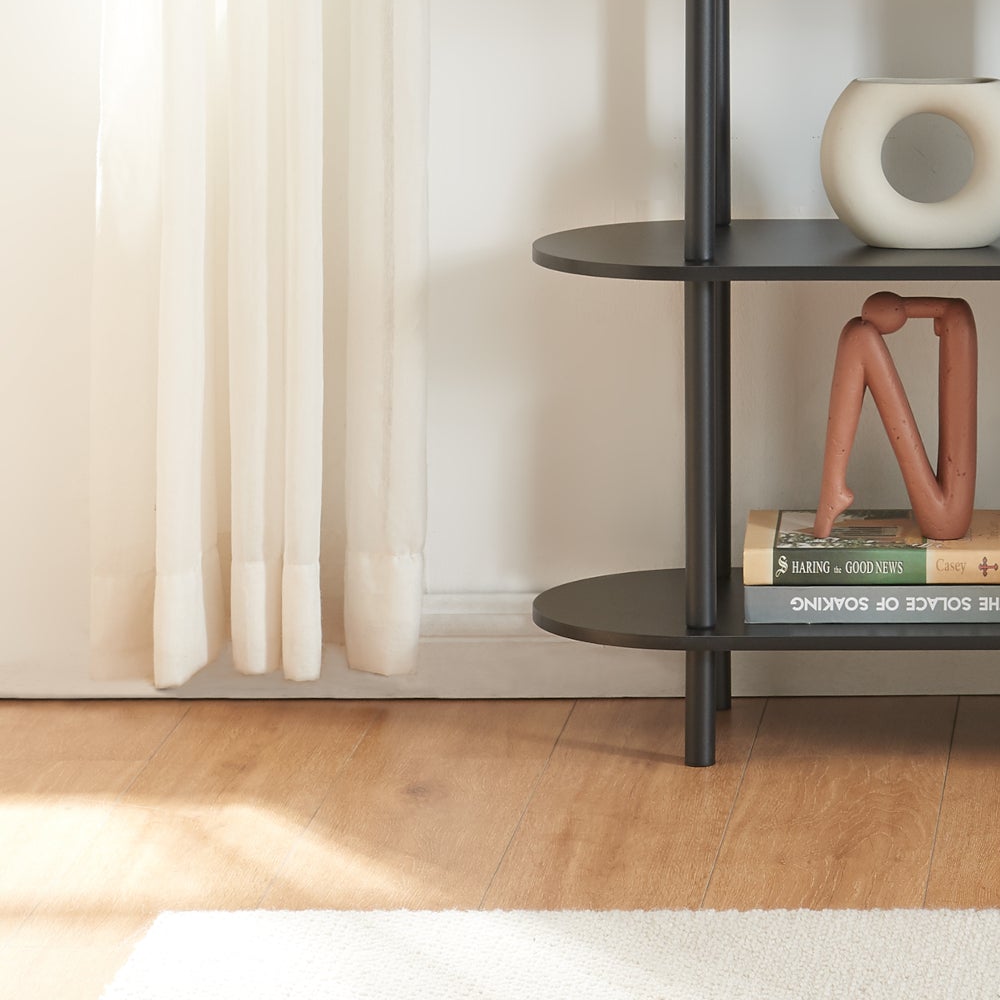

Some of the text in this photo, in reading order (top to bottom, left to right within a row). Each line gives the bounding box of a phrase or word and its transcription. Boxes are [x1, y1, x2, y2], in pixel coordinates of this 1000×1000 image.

[833, 564, 843, 574] the
[845, 560, 874, 574] GOOD
[875, 561, 904, 574] NEWS
[935, 558, 968, 575] Casey
[790, 596, 870, 611] SOAKING
[876, 596, 900, 611] OF
[906, 596, 972, 611] SOLACE
